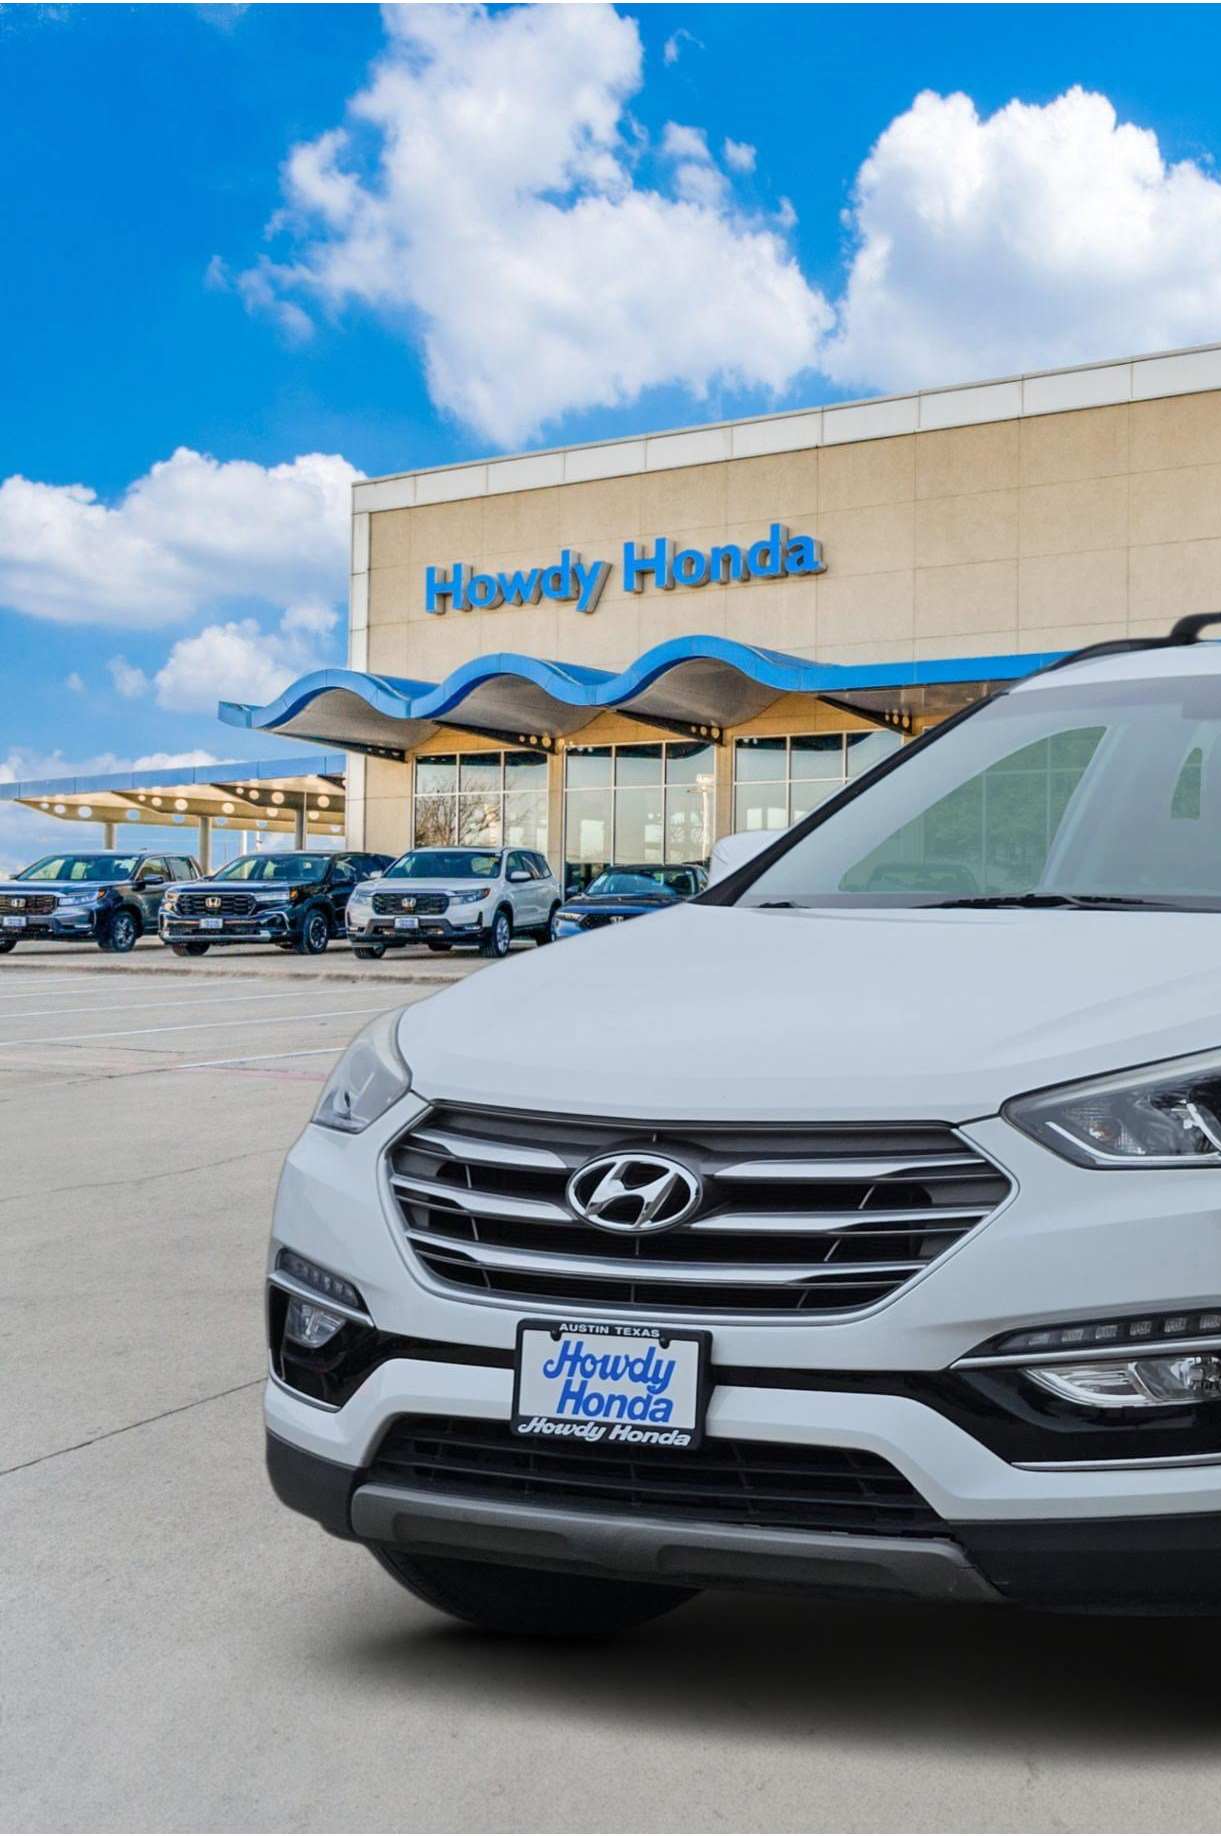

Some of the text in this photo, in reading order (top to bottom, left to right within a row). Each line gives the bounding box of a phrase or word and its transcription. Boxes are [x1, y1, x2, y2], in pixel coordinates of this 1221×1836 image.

[424, 523, 827, 615] Howdy Honda
[559, 1322, 661, 1338] AUSTIN TEXAS
[543, 1340, 676, 1395] Howdy
[556, 1378, 673, 1423] Honda
[518, 1417, 691, 1447] Howdy Honda
